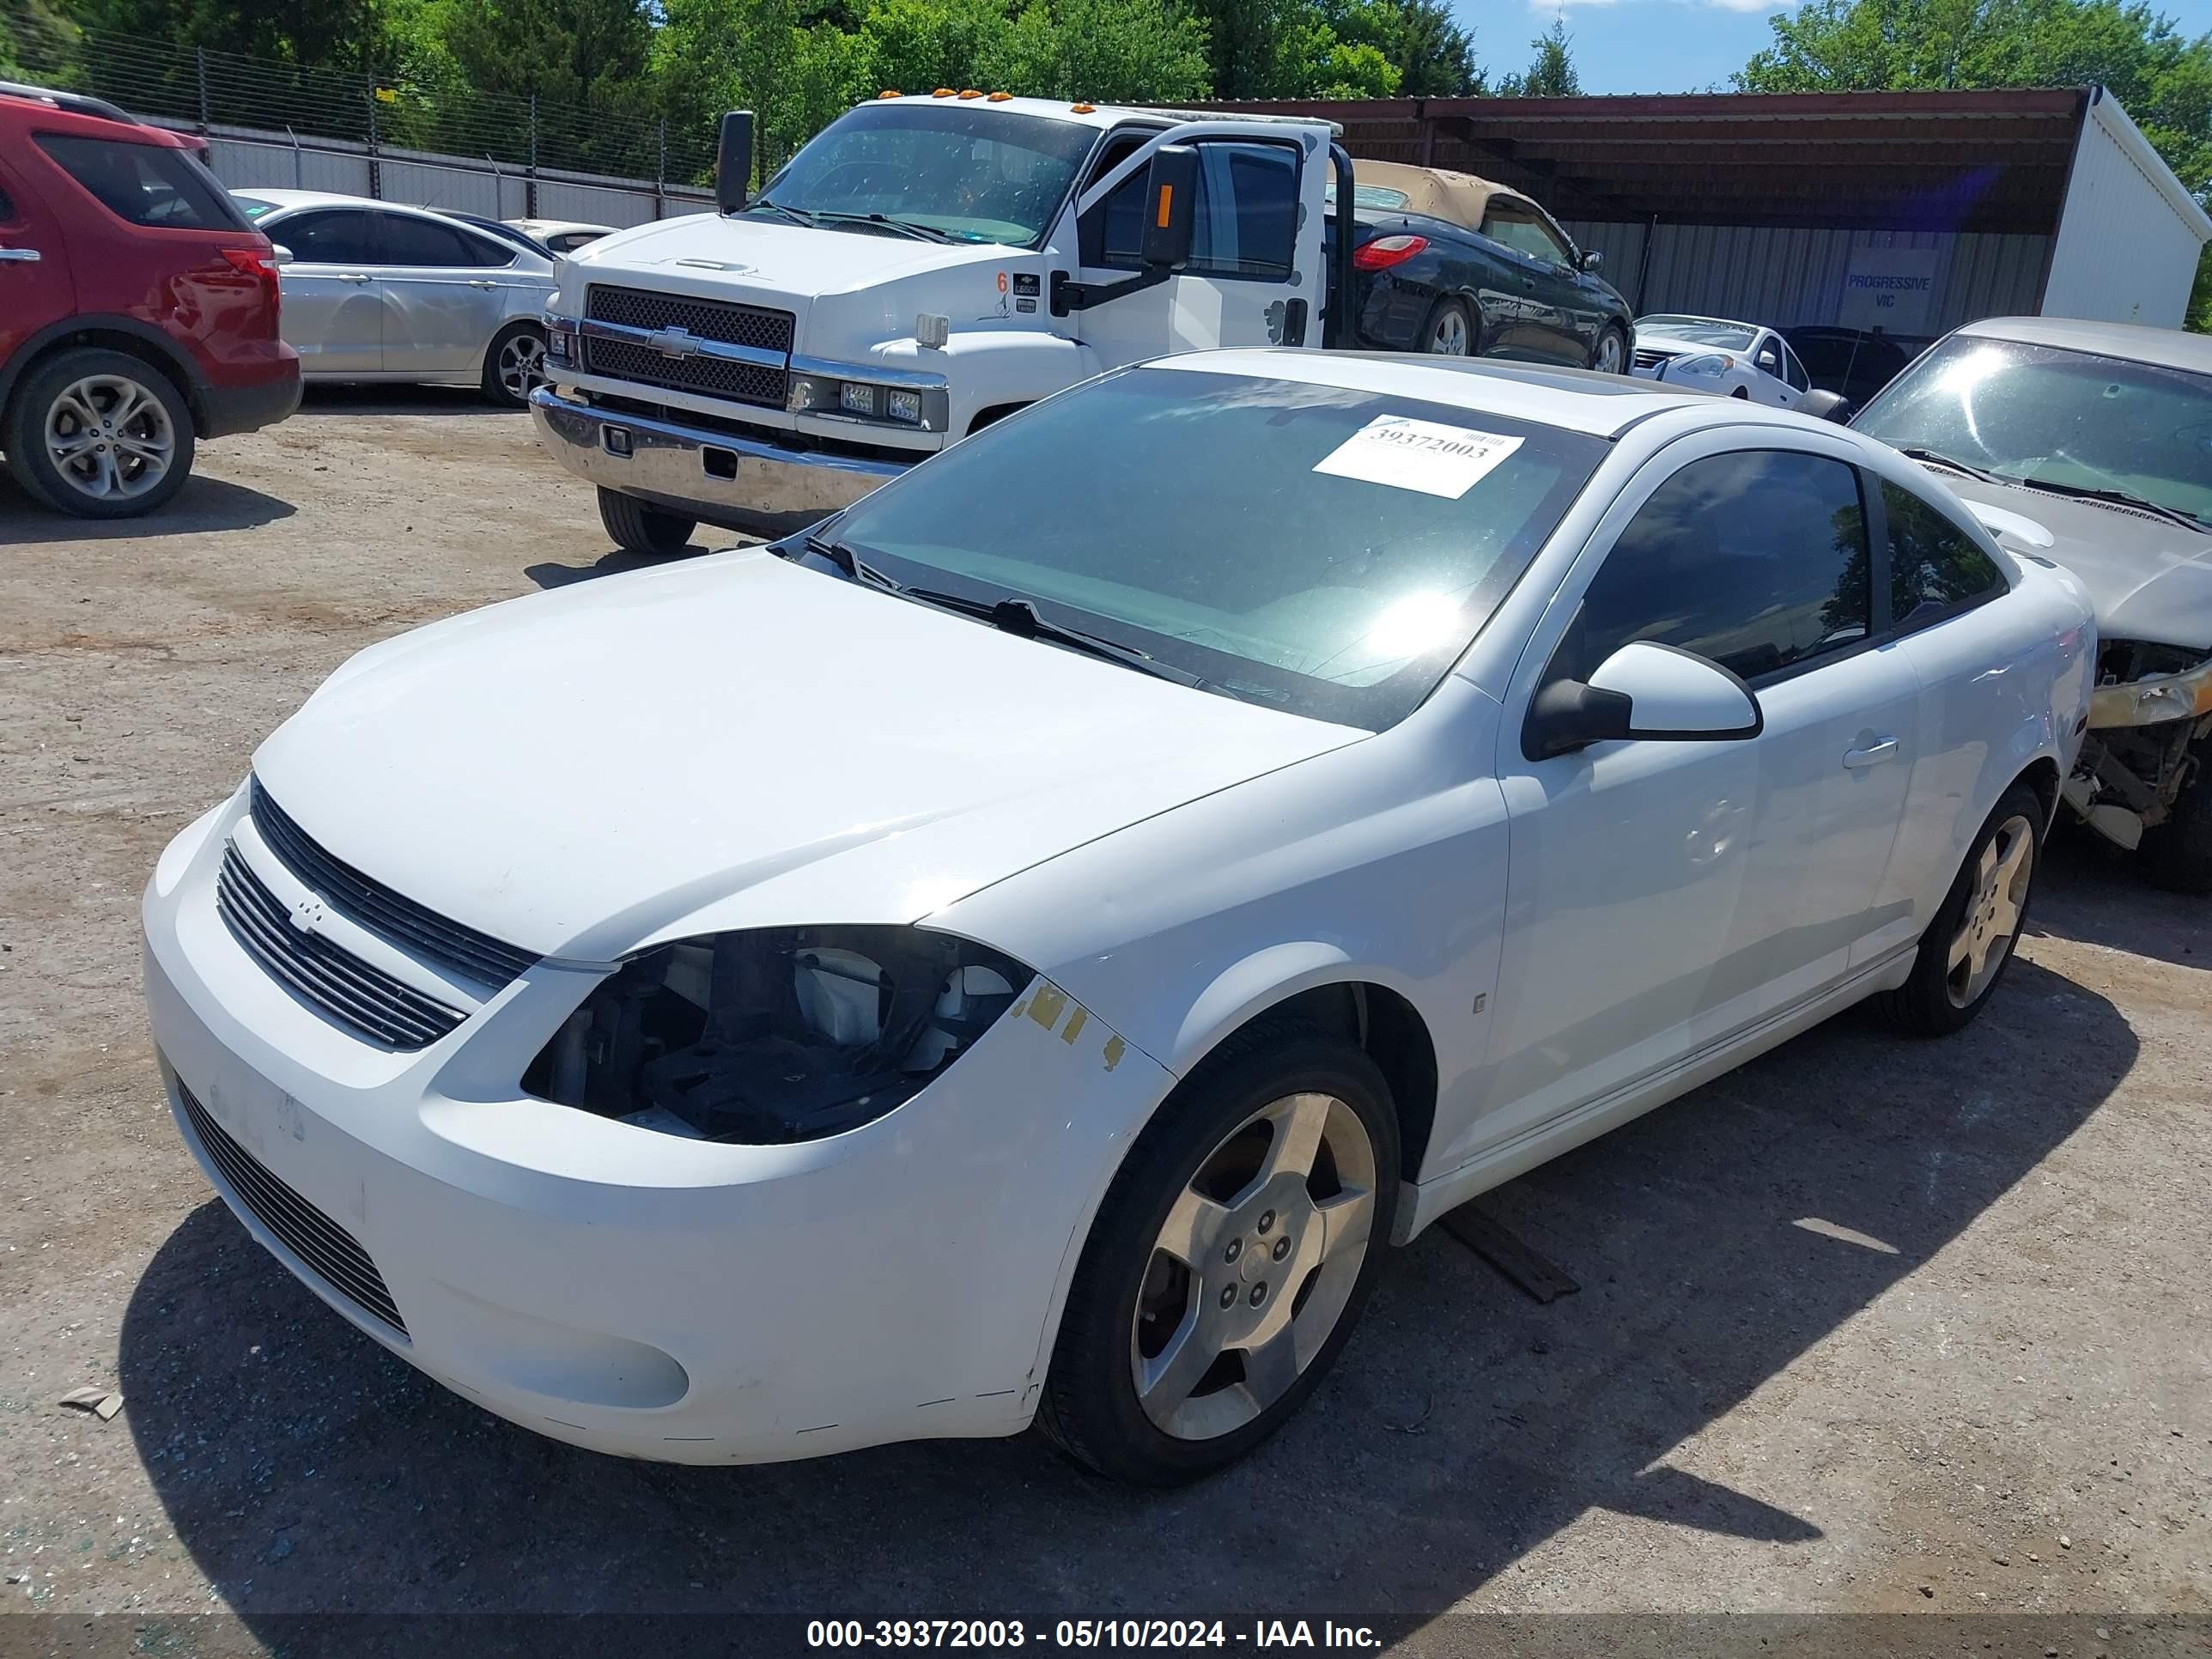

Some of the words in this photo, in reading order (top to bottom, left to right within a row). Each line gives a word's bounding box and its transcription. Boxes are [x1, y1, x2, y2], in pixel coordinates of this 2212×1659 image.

[997, 272, 1007, 293] 6
[1848, 274, 1931, 291] PROGRESSIVE
[1876, 294, 1895, 307] VIC
[1370, 428, 1489, 459] 39372003
